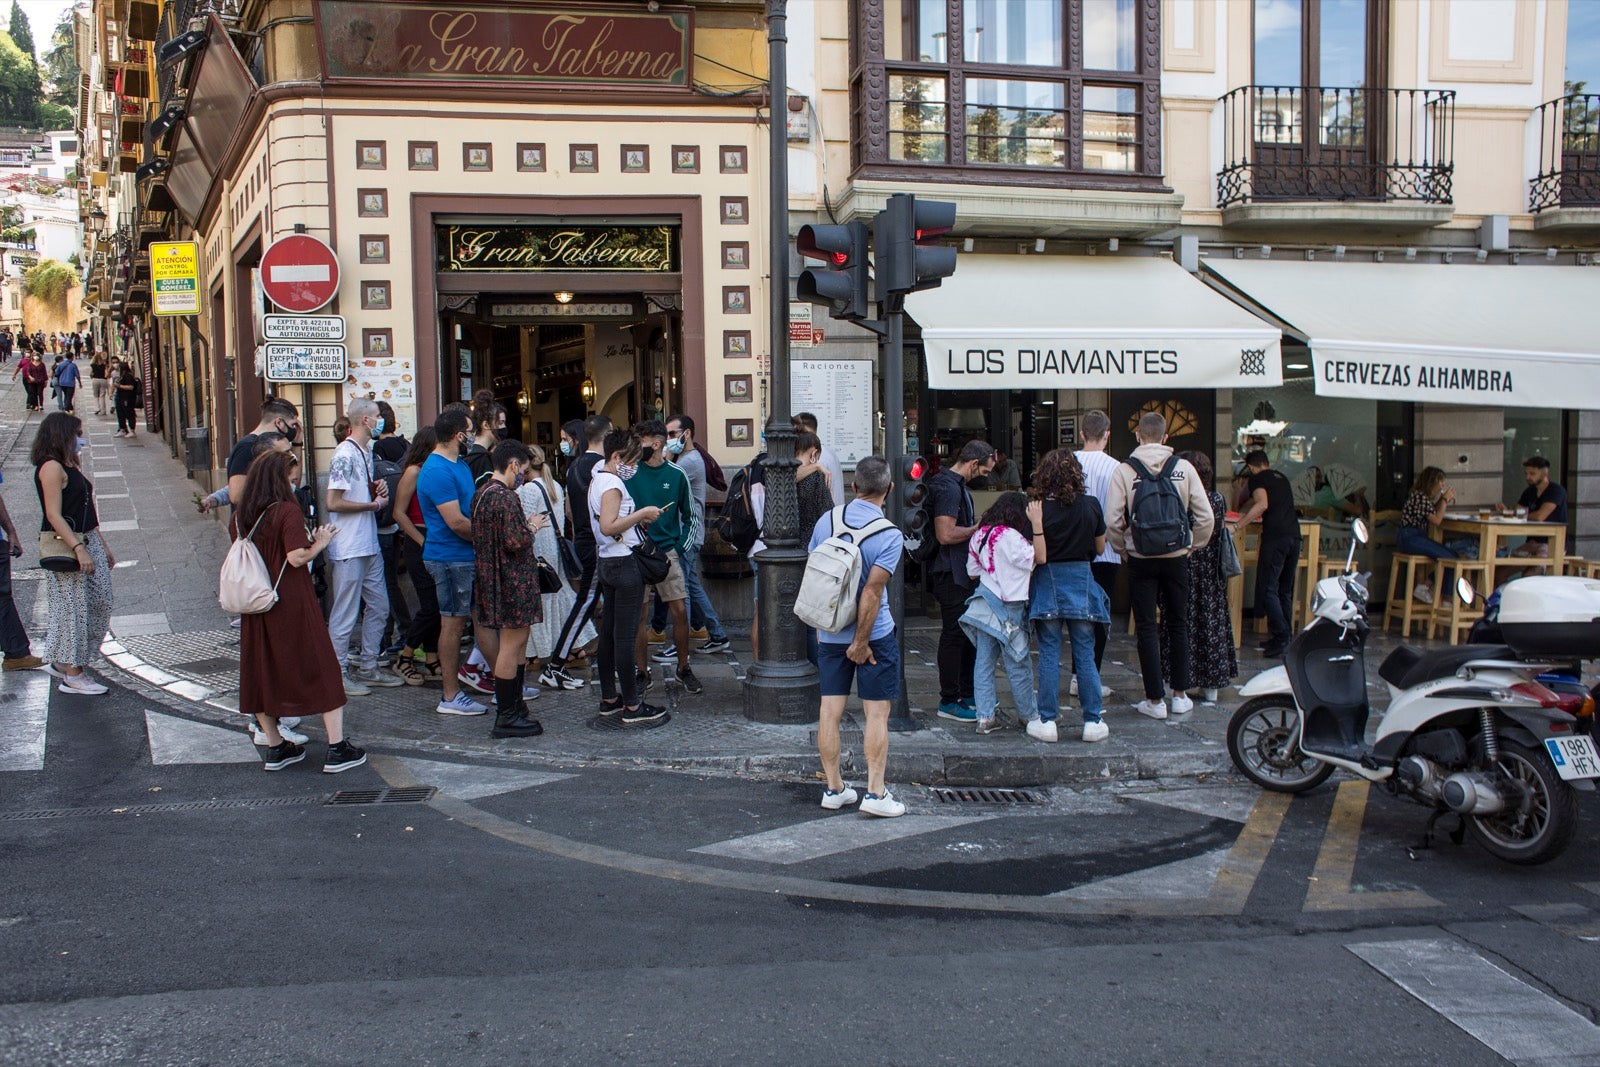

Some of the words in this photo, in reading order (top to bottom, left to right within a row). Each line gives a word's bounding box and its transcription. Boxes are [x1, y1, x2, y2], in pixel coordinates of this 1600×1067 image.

[429, 12, 529, 73] Gran
[533, 15, 677, 78] Taberna
[460, 230, 537, 262] Gran
[541, 231, 660, 264] Taberna
[948, 349, 1004, 374] LOS
[1018, 349, 1178, 374] DIAMANTES
[1325, 360, 1410, 387] CERVEZAS
[1417, 366, 1513, 392] ALHAMBRA
[1561, 738, 1592, 756] 1981
[1572, 756, 1600, 775] HFX
